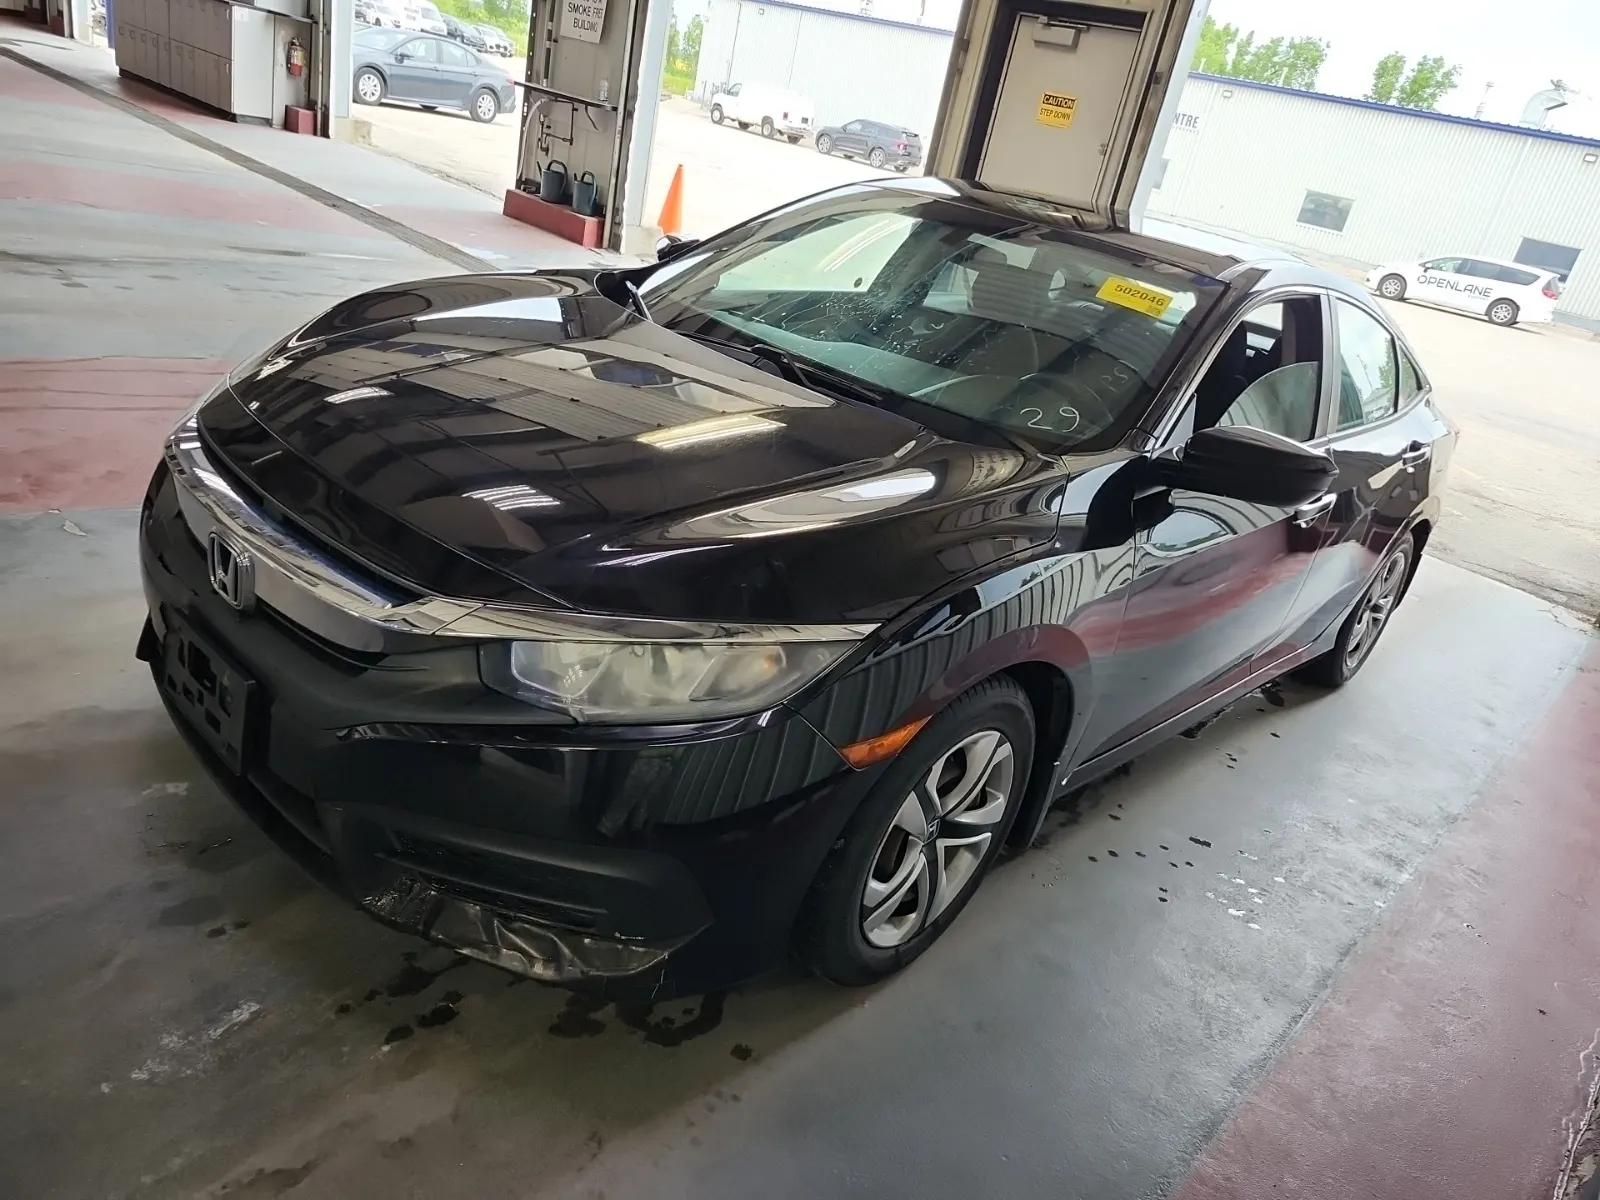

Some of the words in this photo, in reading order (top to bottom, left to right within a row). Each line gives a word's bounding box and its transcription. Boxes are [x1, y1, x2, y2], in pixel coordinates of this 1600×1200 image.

[568, 2, 592, 17] SMOKE
[592, 7, 604, 19] FREE
[573, 17, 599, 33] BUILDING
[1043, 95, 1075, 109] CAUTION
[1040, 107, 1054, 117] STEP
[1054, 110, 1071, 121] DOWN
[1417, 274, 1494, 298] OPENLANE
[1114, 284, 1166, 307] 502046
[1020, 406, 1080, 433] 29
